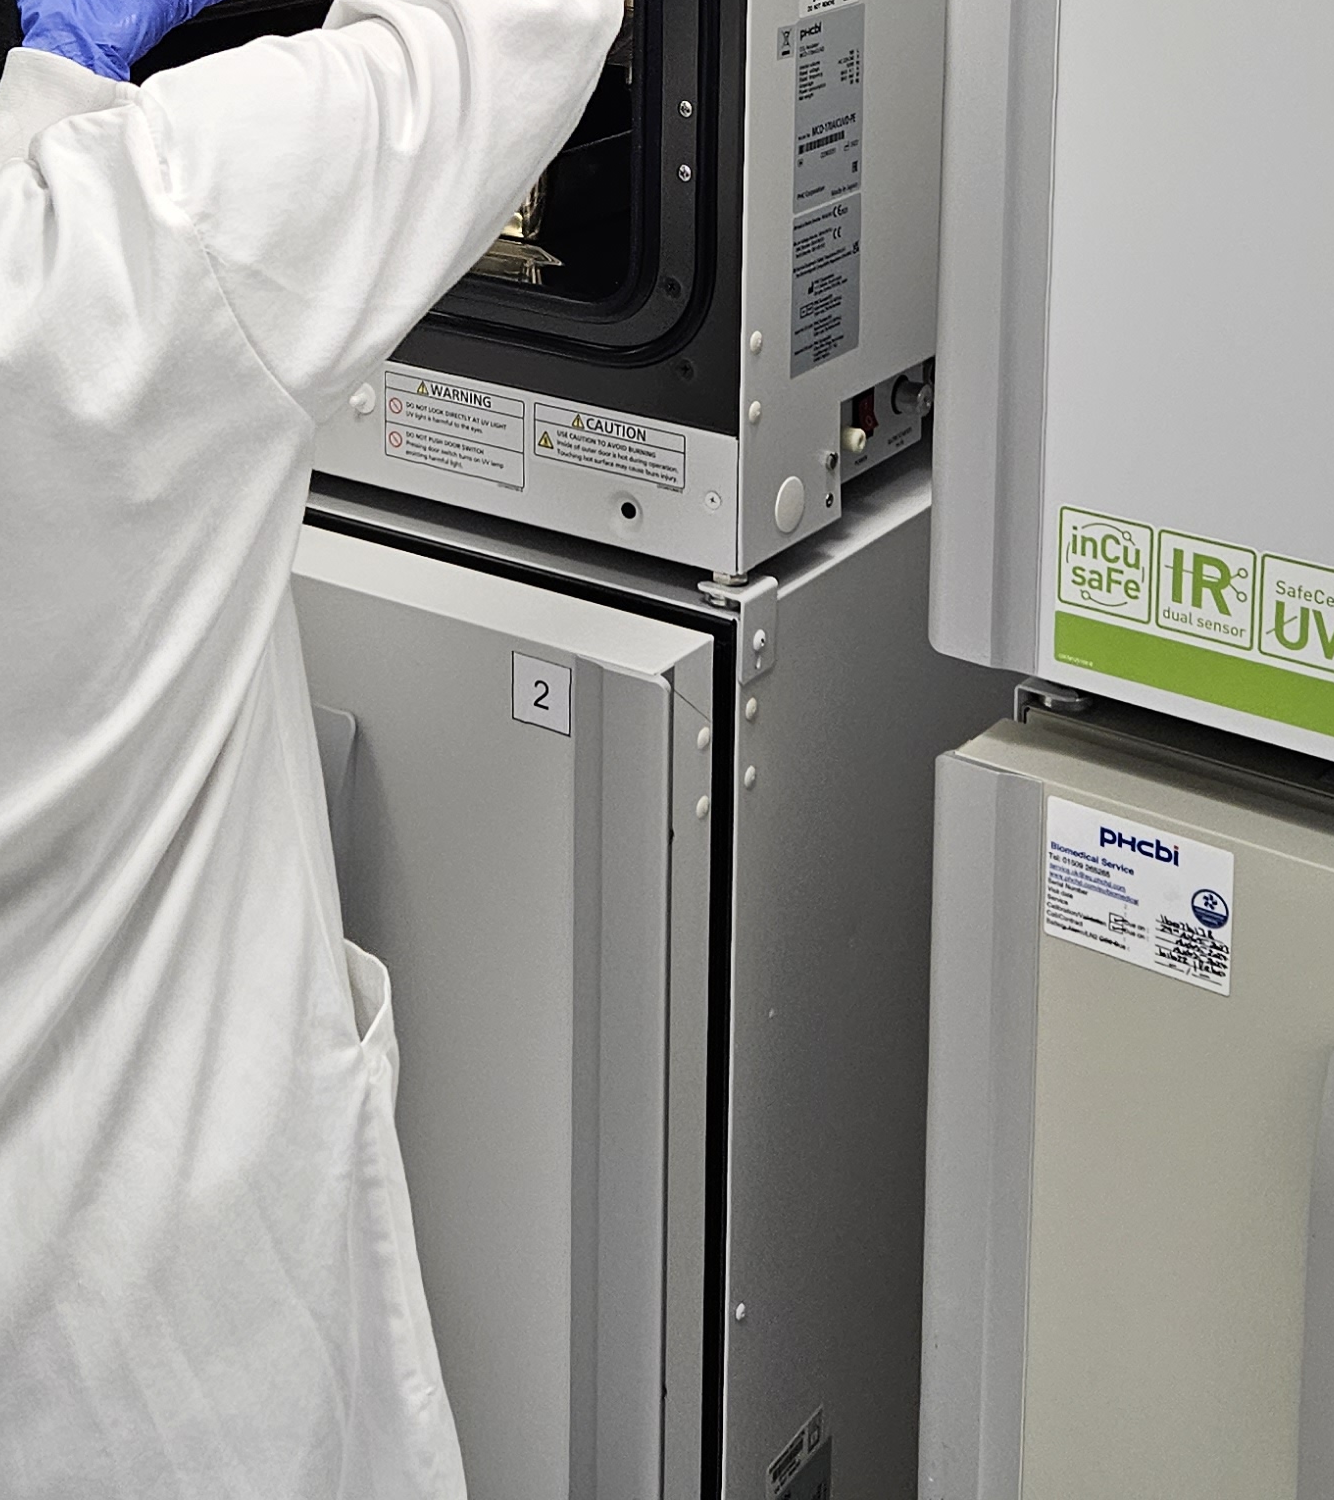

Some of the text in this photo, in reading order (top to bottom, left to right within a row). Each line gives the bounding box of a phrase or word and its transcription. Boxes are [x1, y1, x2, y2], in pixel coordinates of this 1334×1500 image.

[430, 383, 492, 409] WARNING
[416, 404, 428, 412] NOT
[428, 406, 444, 416] LOOK
[445, 410, 471, 421] DIRECTLY
[480, 418, 489, 426] UV
[490, 420, 507, 430] LIGHT
[586, 417, 647, 442] CAUTION
[406, 431, 485, 455] DO NOT PUSH DOOR SWITCH
[556, 429, 657, 459] USE CAUTION TO AVOID BURNING
[1171, 547, 1233, 618] IR
[1162, 606, 1247, 638] dual sensor
[533, 679, 549, 710] 2
[1050, 840, 1135, 876] Biomedical Service
